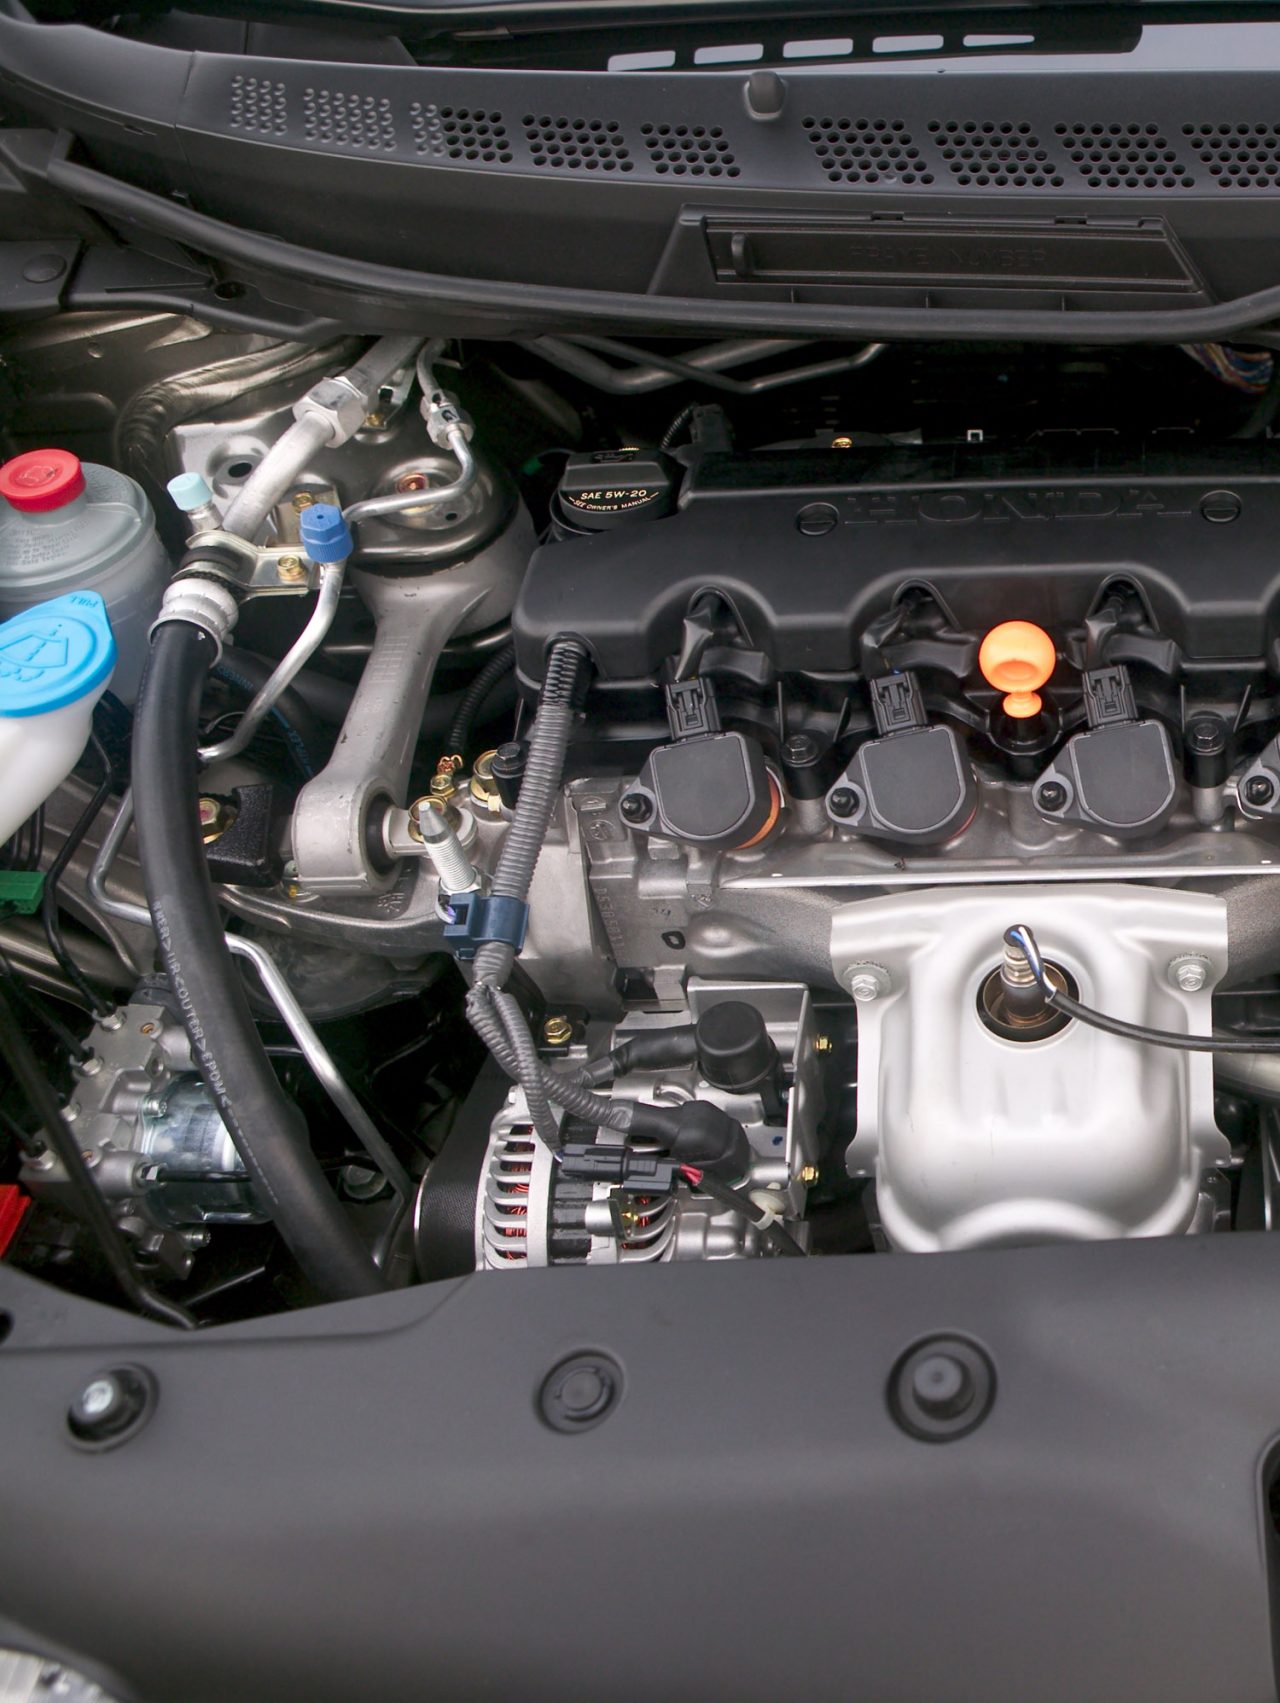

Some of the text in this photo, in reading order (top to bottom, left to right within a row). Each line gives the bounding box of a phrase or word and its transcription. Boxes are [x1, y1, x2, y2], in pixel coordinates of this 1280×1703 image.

[581, 489, 647, 500] SAE 5W-20
[573, 496, 651, 511] SEE OWNER'S MANUAL
[845, 488, 1191, 523] HONDA
